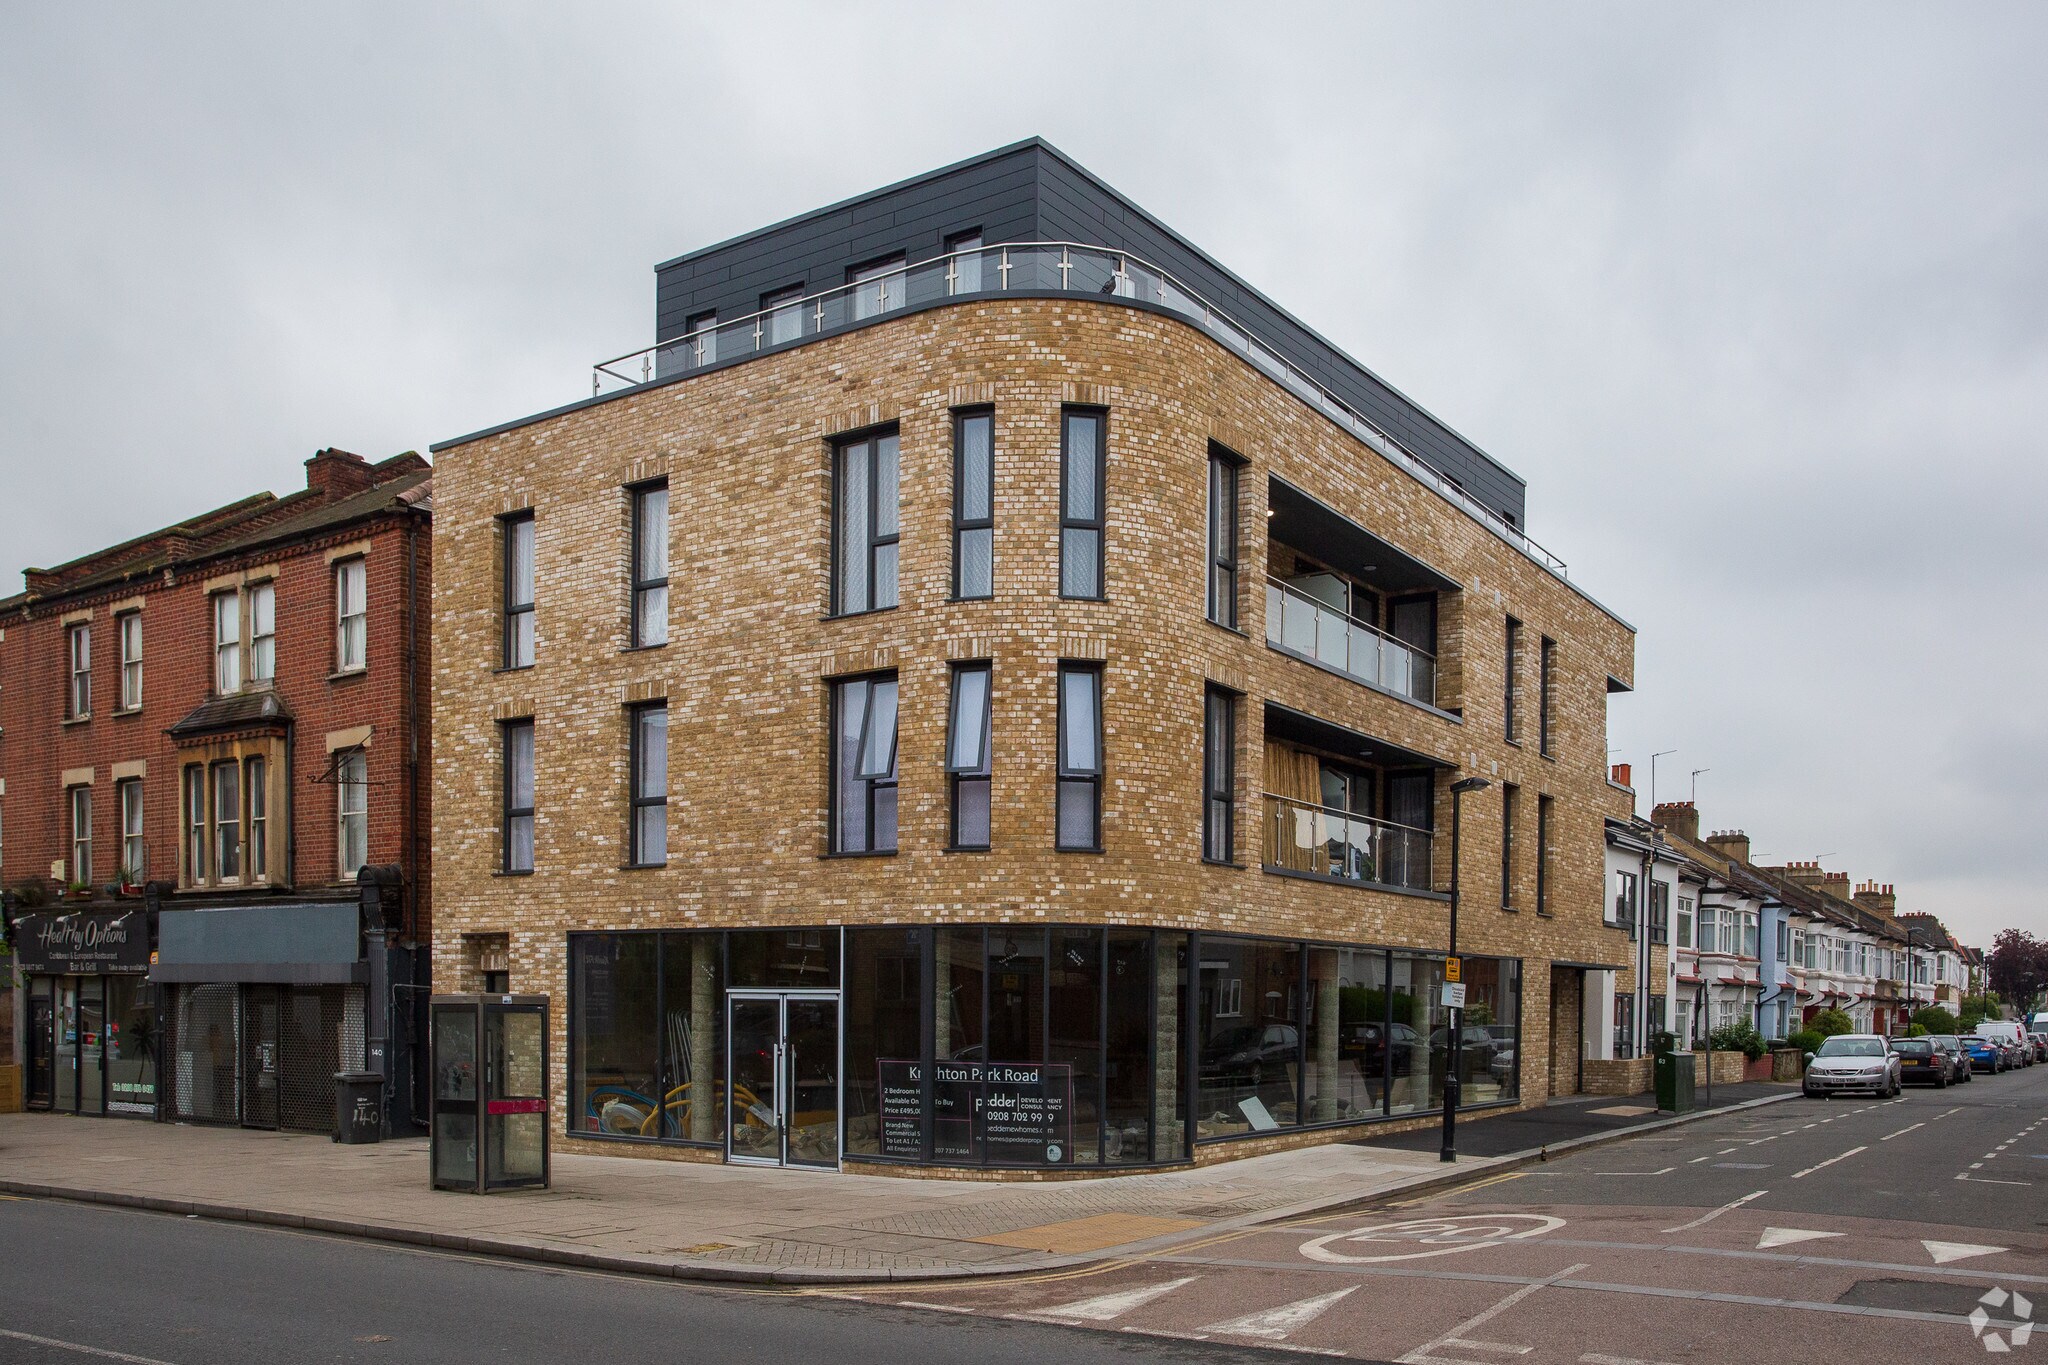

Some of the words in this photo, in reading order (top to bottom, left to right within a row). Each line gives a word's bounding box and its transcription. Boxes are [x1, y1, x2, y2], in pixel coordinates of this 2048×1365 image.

[37, 920, 84, 951] Healthy
[85, 920, 127, 950] Options
[69, 962, 79, 971] Bar
[85, 962, 97, 971] Grill
[371, 1048, 382, 1056] 140
[1004, 1068, 1038, 1082] Road
[889, 1087, 915, 1095] Bedroom
[942, 1099, 954, 1107] Buy
[975, 1092, 1016, 1112] pdder
[353, 1108, 379, 1128] 140
[987, 1111, 1009, 1121] 0208
[1012, 1112, 1028, 1122] 702
[1030, 1112, 1054, 1123] 999
[885, 1129, 917, 1137] Commercial
[894, 1145, 918, 1153] Enquiries
[955, 1147, 970, 1155] 1464
